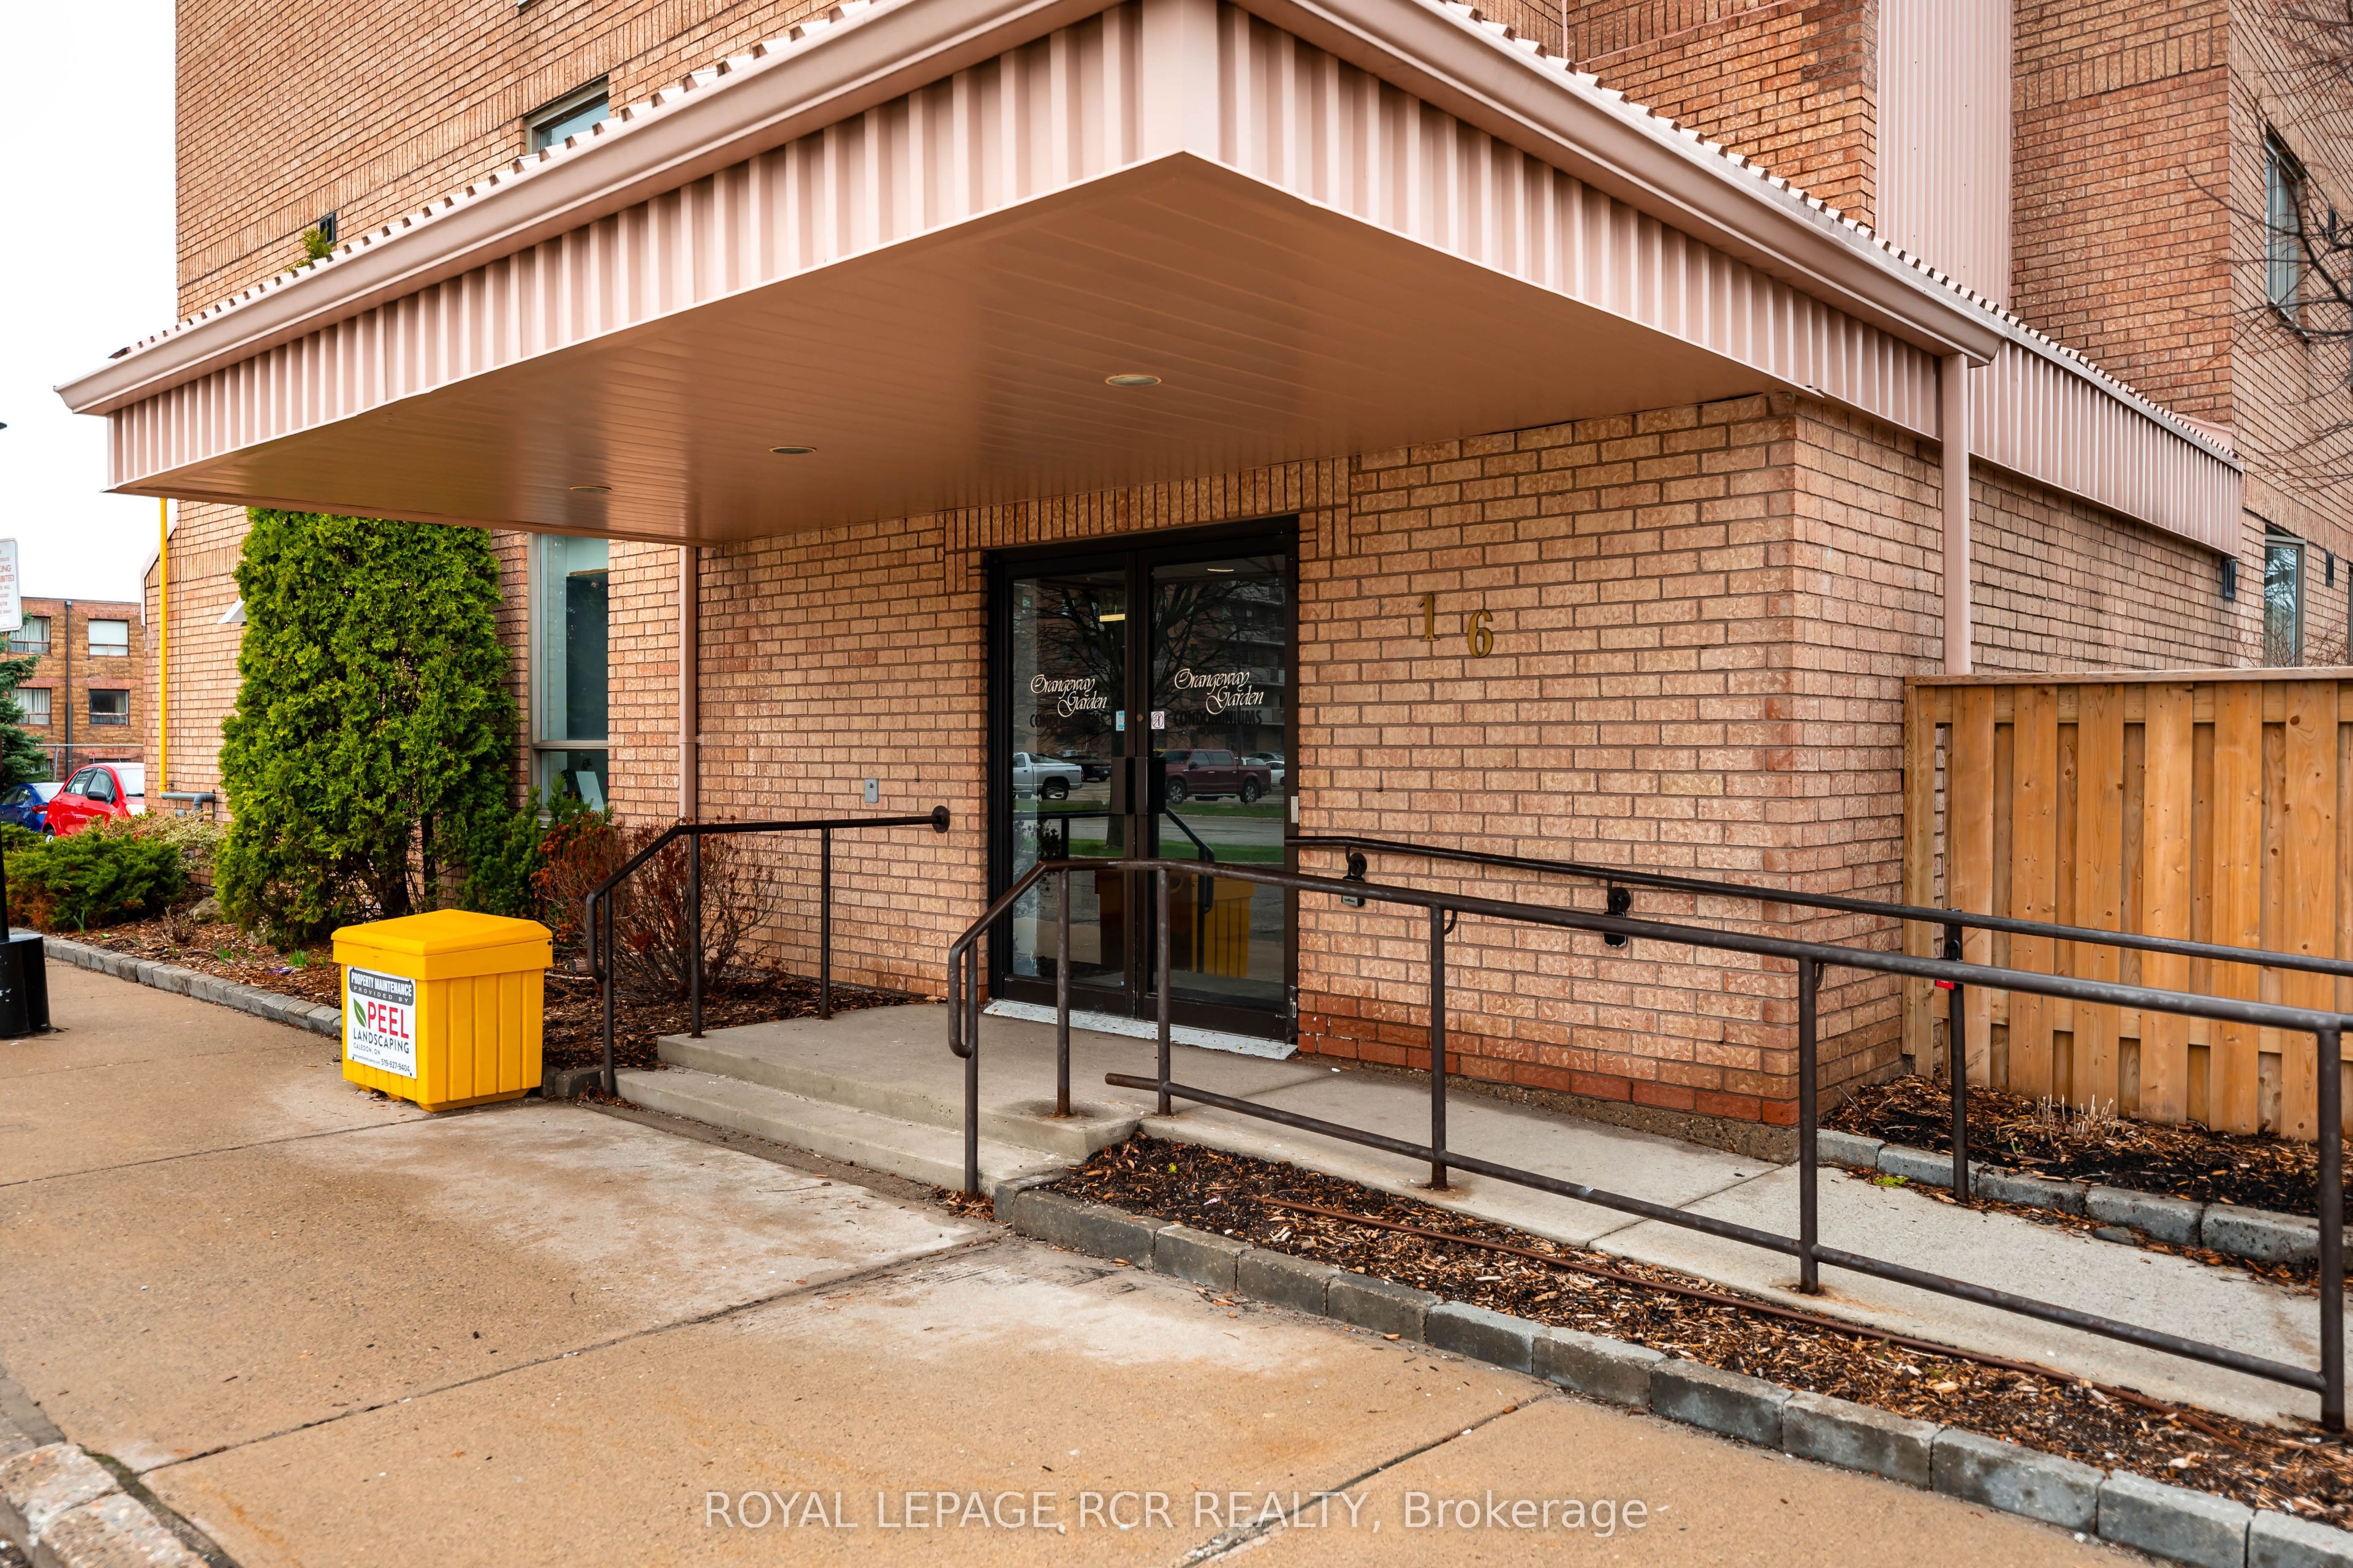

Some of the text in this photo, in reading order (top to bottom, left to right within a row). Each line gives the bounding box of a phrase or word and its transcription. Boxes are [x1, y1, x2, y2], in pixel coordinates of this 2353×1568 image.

[1030, 674, 1096, 699] Orangeway
[1175, 668, 1250, 695] Orangeway
[1057, 690, 1107, 718] Garden
[1205, 684, 1264, 715] Garden
[351, 971, 412, 997] PROPERTY MAINTENANCE
[354, 985, 393, 1000] PROVIDED
[368, 1001, 409, 1039] PEEL
[353, 1027, 410, 1055] LANDSCAPING
[381, 1058, 410, 1072] 519-927-9404
